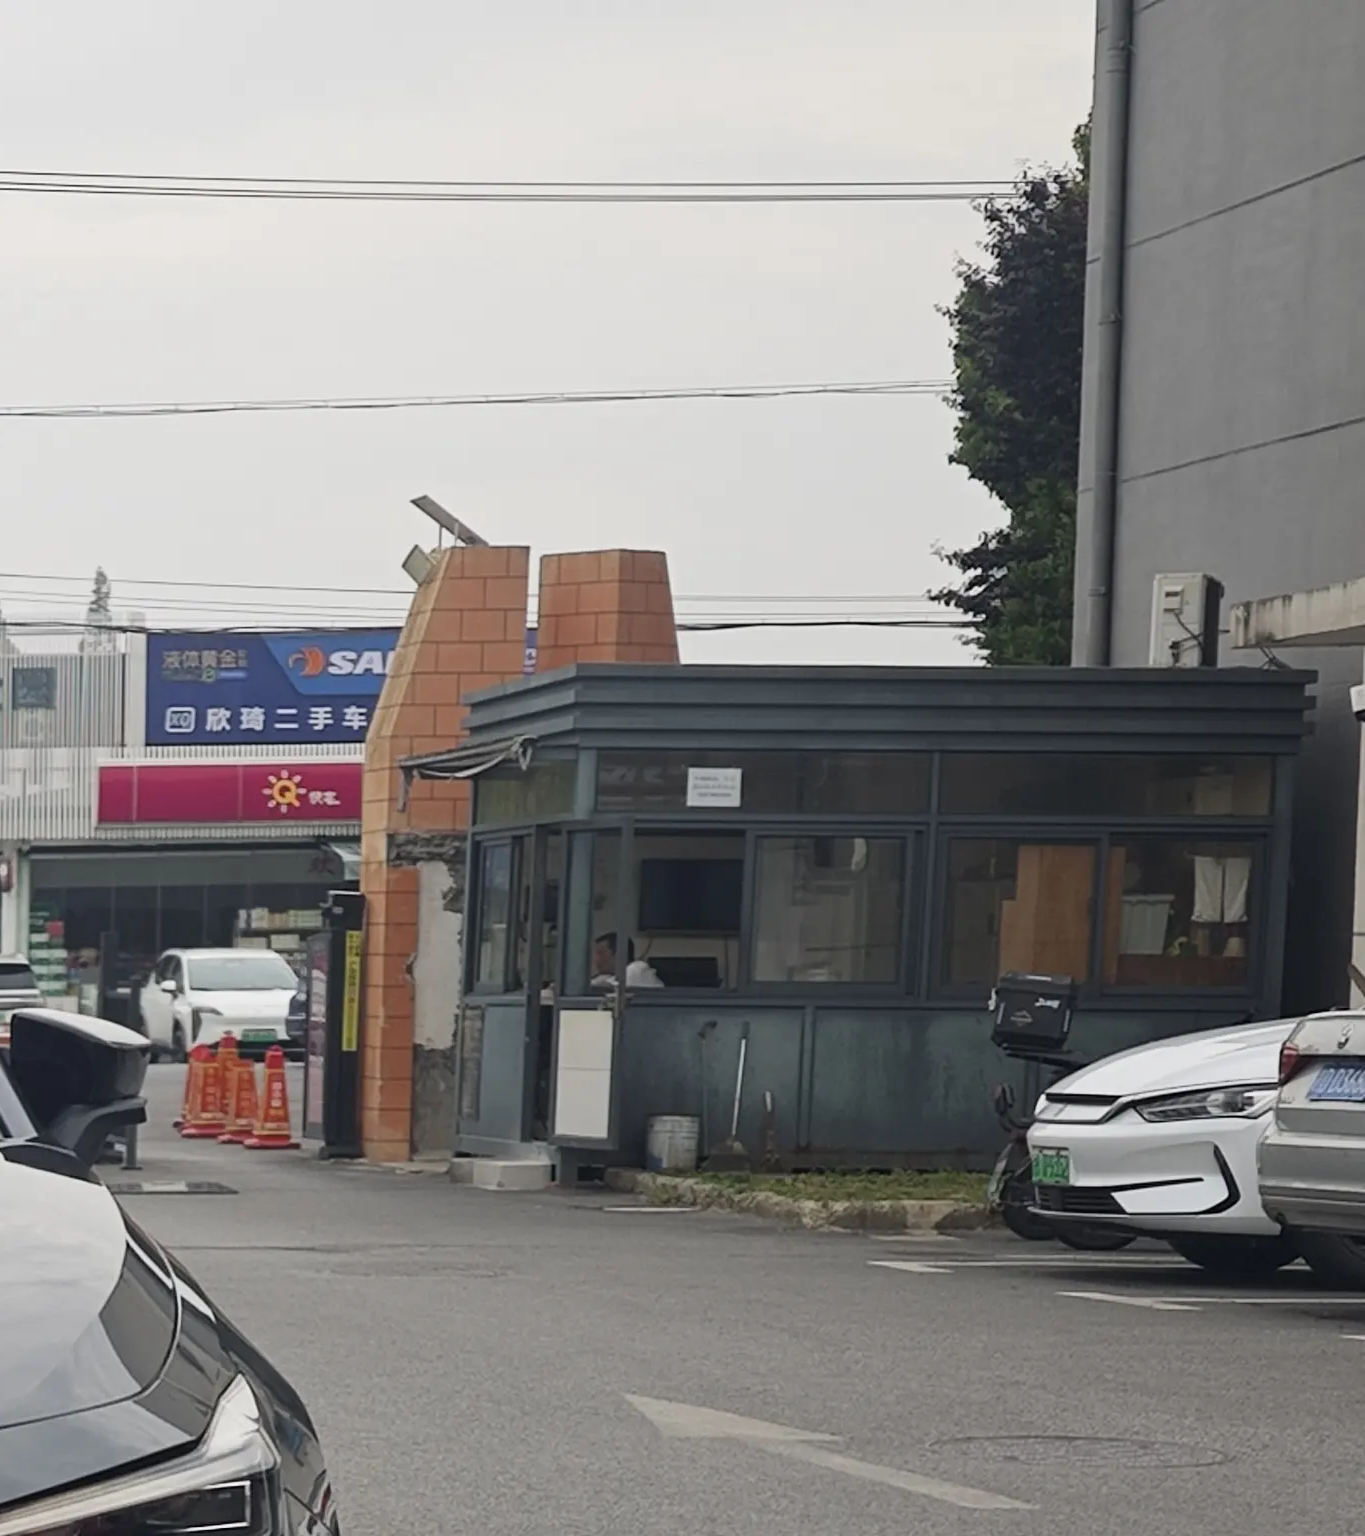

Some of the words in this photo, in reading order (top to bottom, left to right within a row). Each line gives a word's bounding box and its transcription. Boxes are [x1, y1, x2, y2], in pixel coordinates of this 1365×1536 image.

[205, 705, 368, 732] 欣琦二手车
